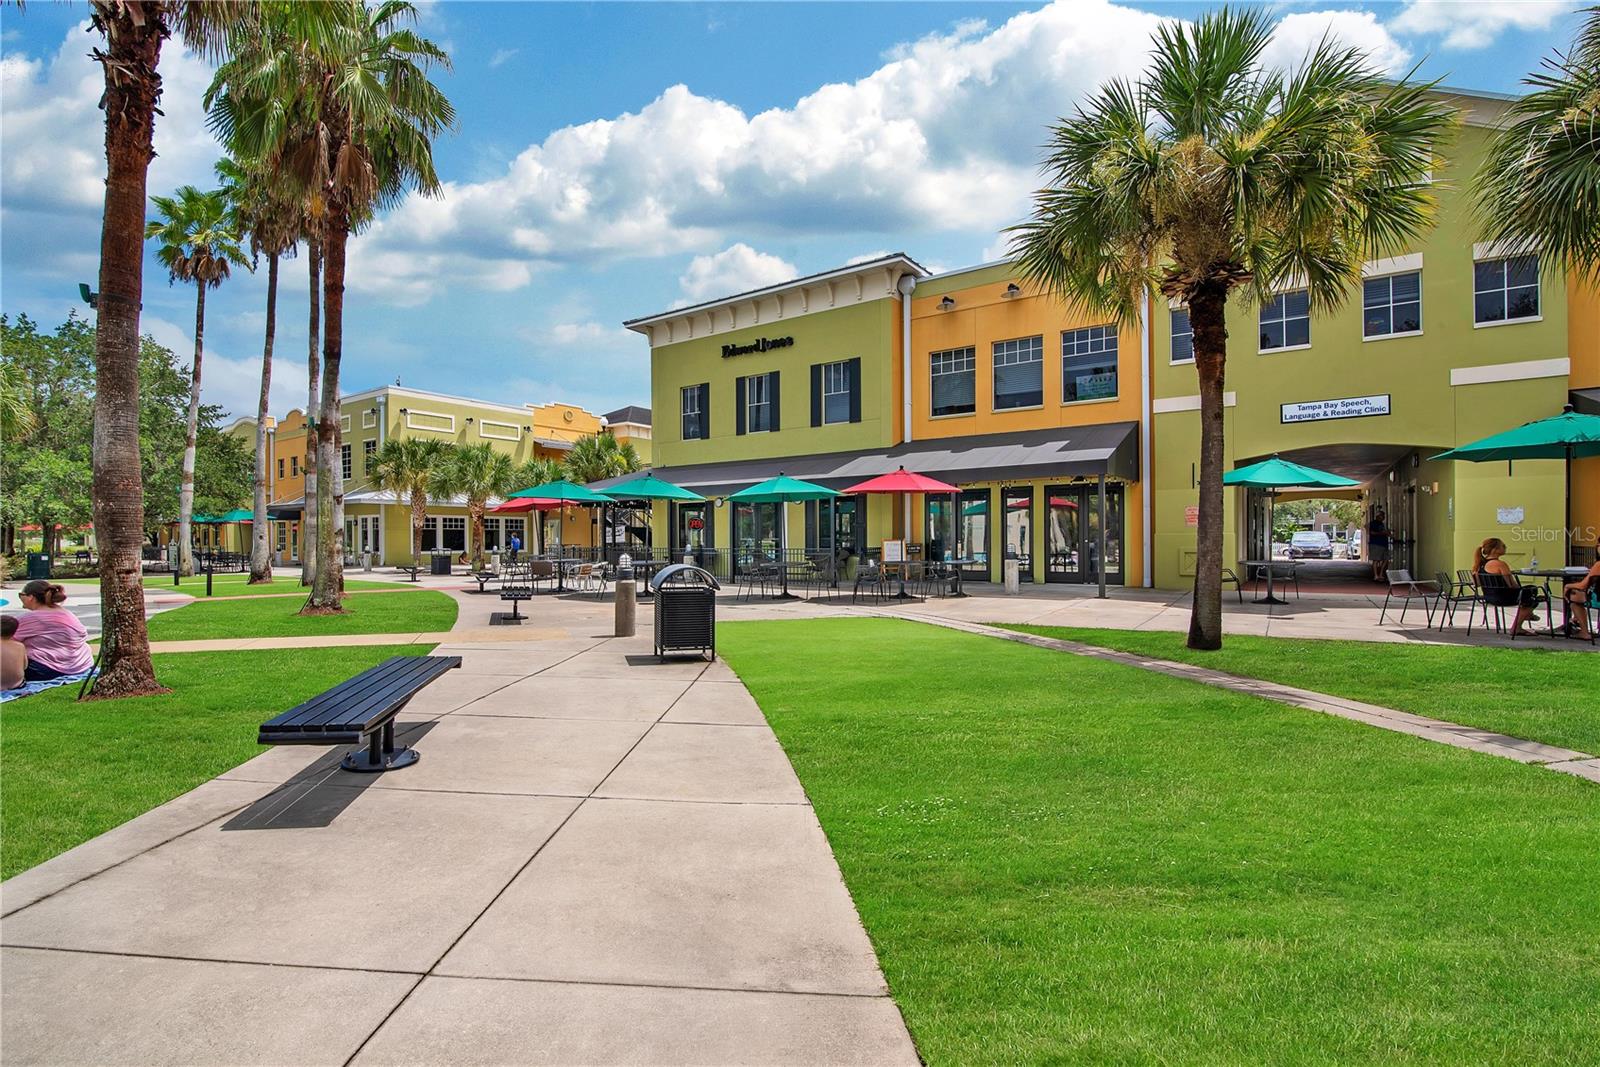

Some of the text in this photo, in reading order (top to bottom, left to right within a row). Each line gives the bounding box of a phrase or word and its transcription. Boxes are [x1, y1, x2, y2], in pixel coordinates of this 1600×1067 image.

[1284, 411, 1321, 420] Language
[1330, 408, 1363, 417] Reading
[1364, 405, 1387, 413] Clinic
[1297, 399, 1372, 412] Tampa Bay Speech,
